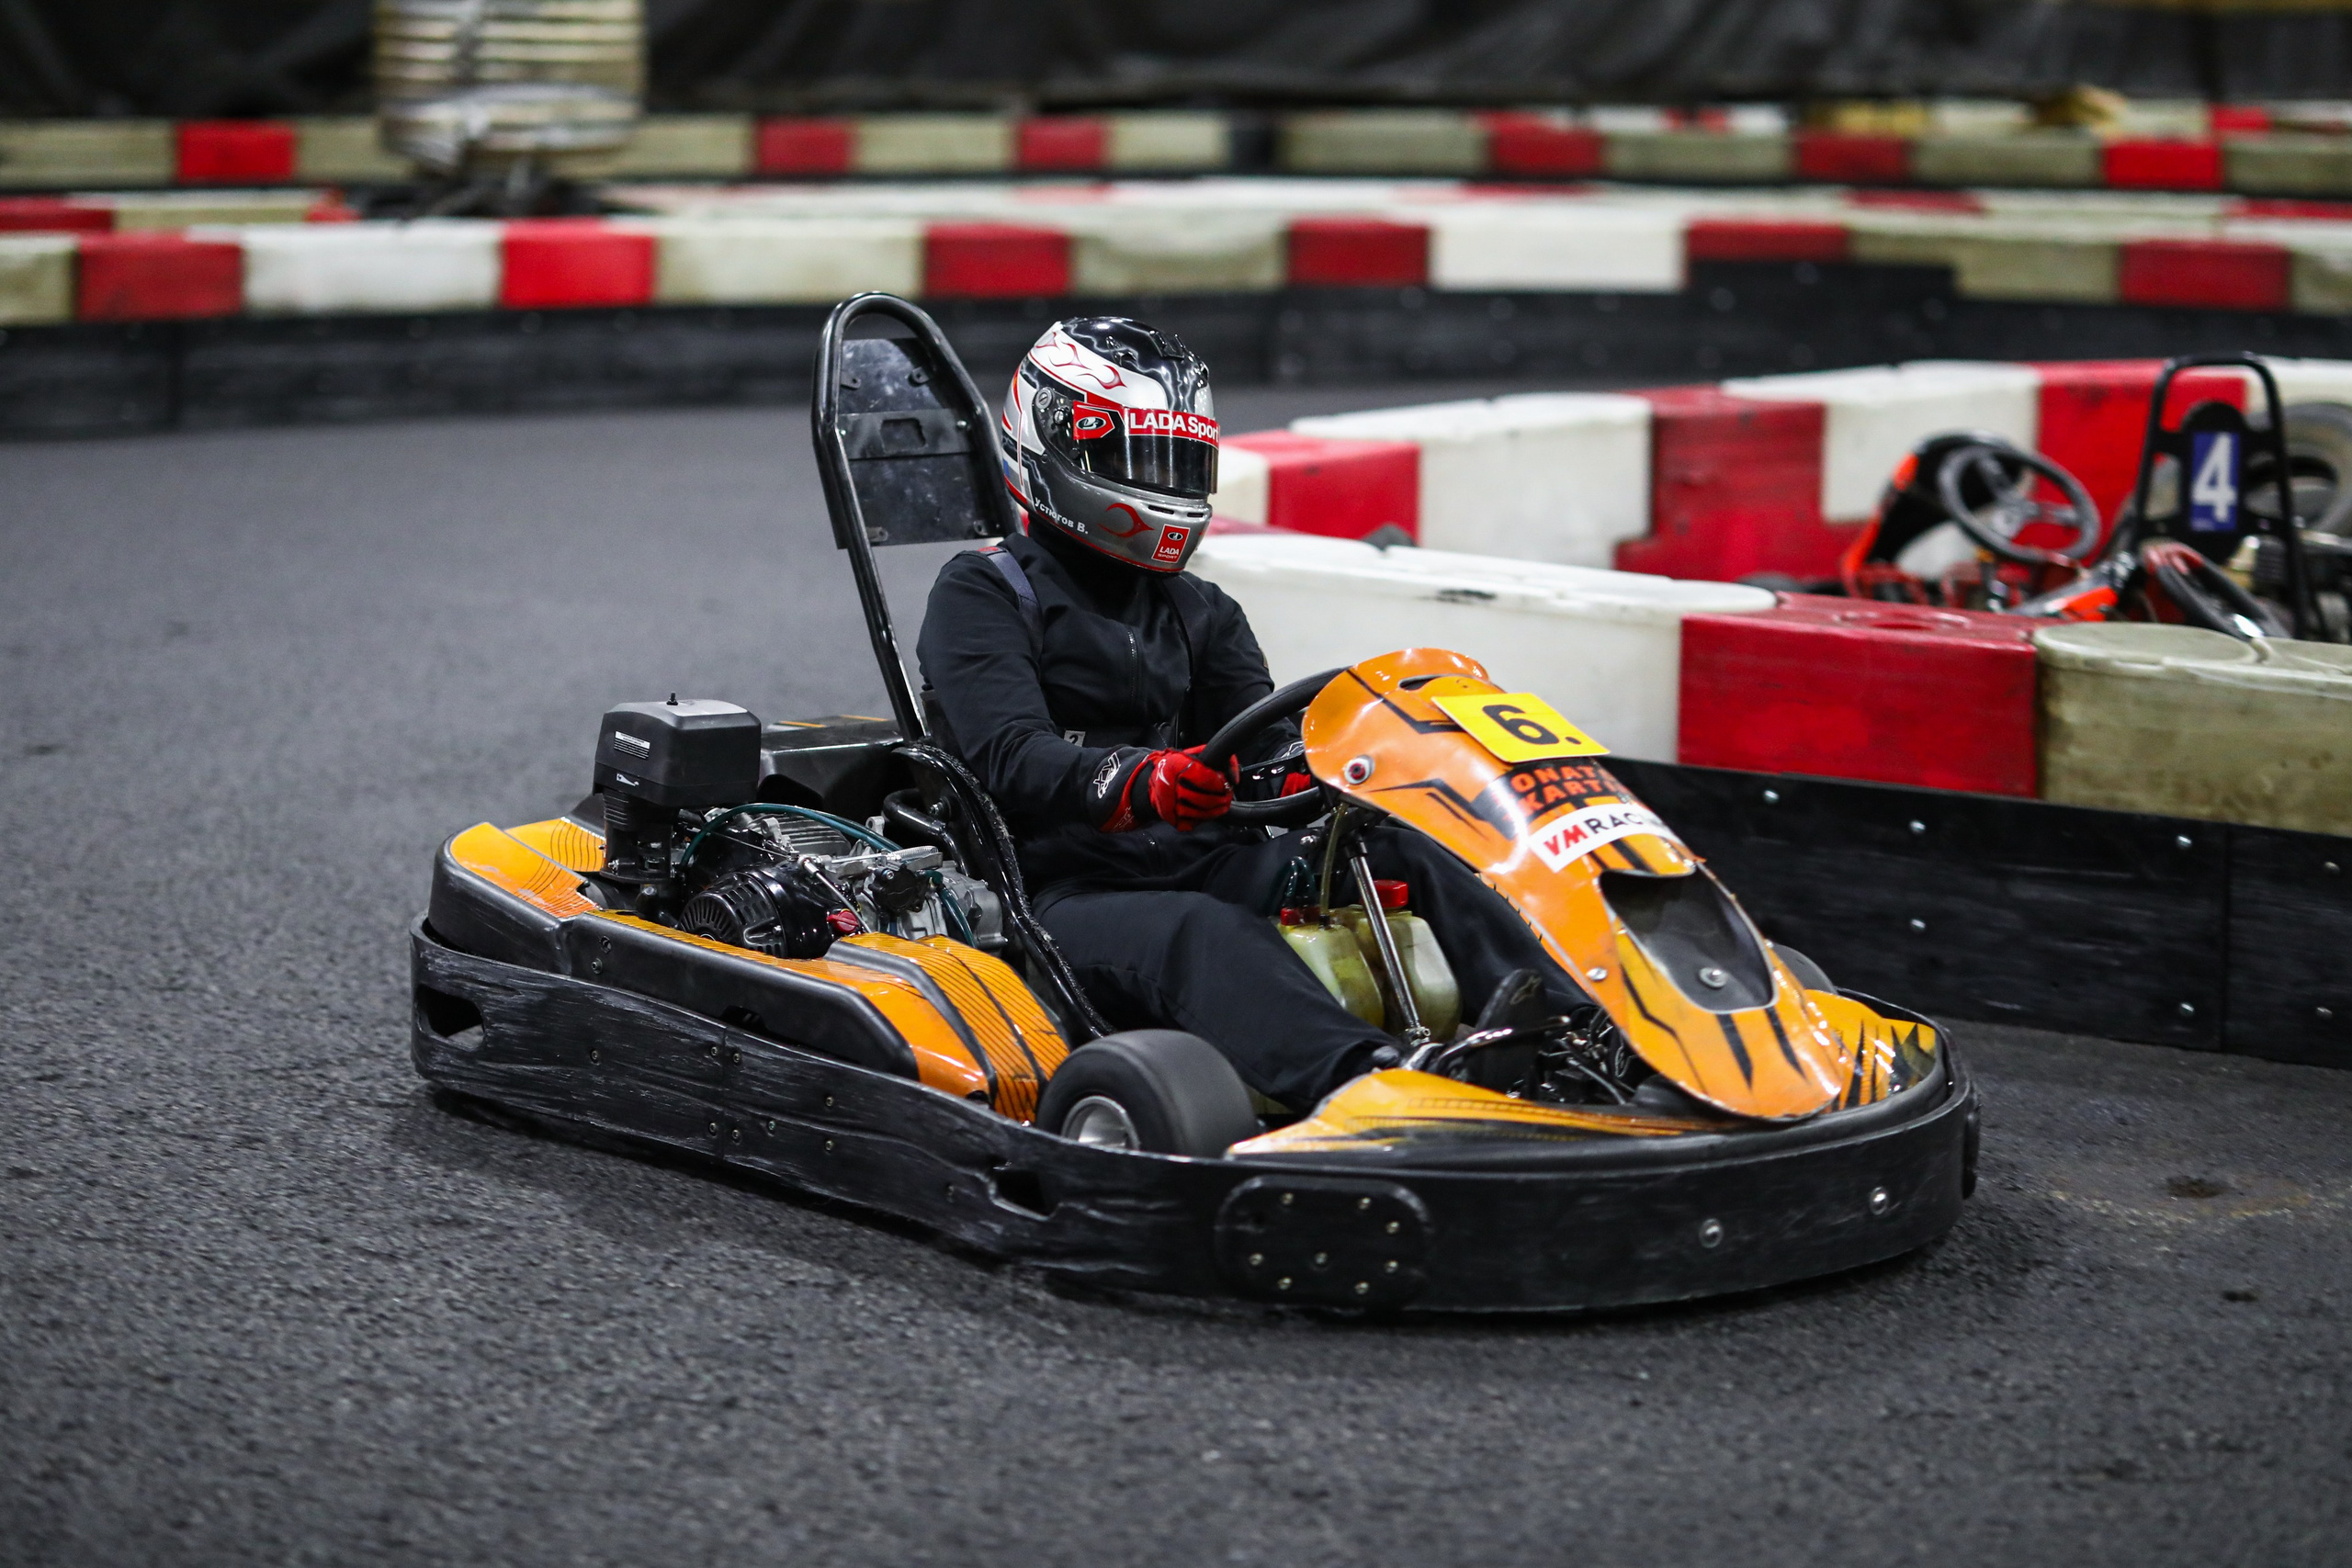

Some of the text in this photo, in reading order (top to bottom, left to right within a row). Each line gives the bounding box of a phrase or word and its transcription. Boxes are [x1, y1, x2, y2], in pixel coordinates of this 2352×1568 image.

[1129, 412, 1220, 443] LADA Sport
[2192, 432, 2237, 523] 4
[1035, 497, 1089, 535] Устюгов В.
[1159, 546, 1180, 556] LADA
